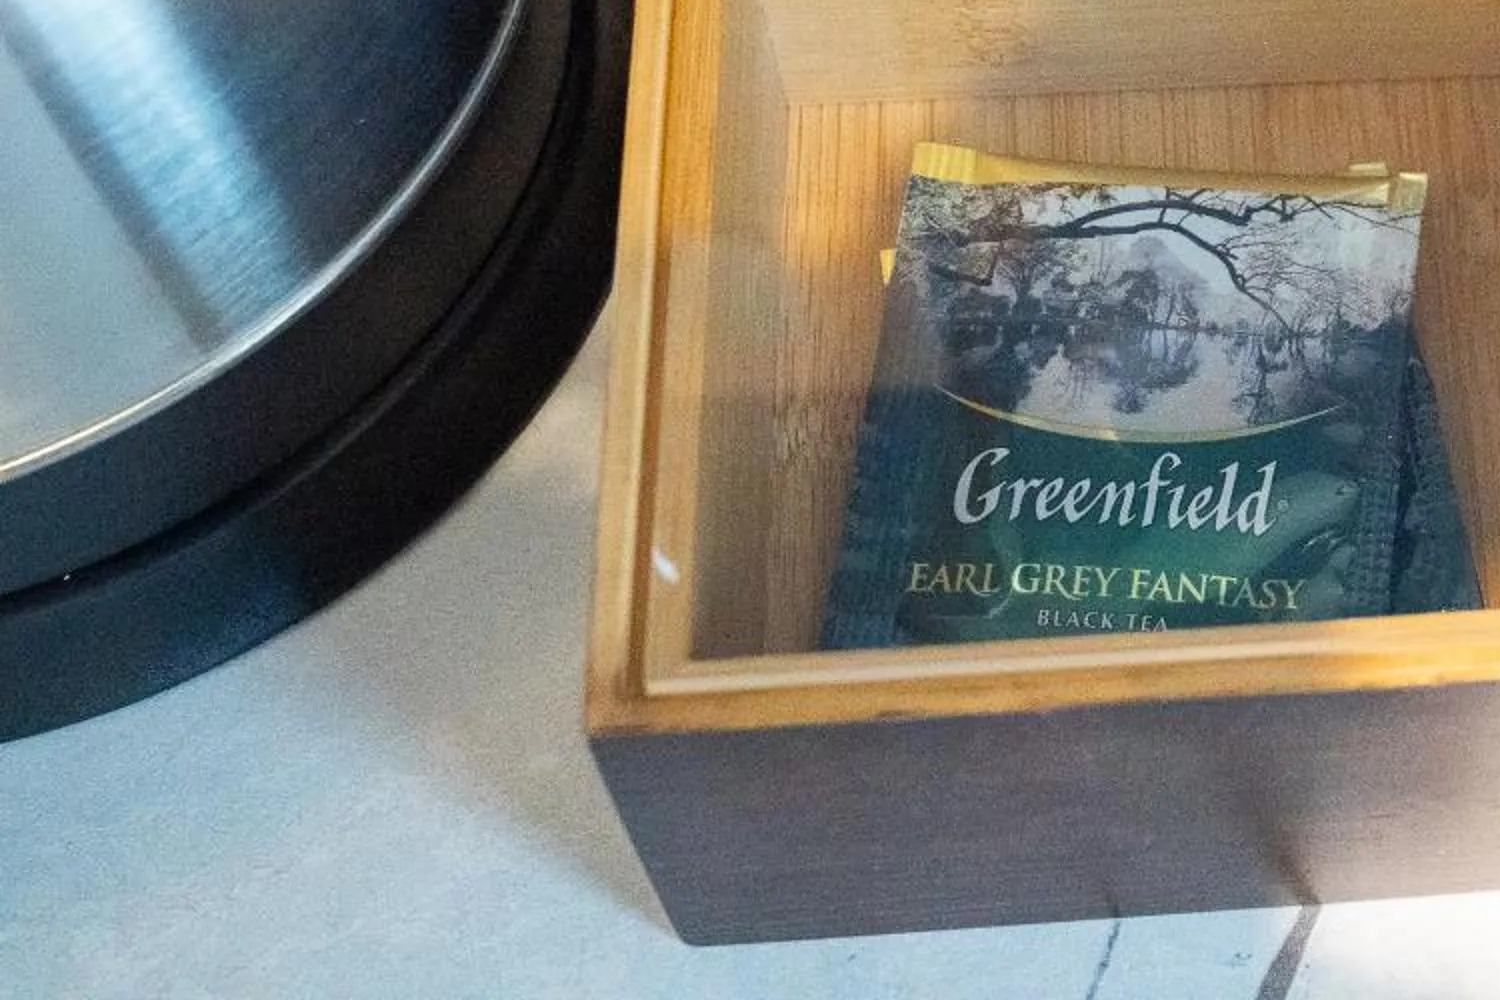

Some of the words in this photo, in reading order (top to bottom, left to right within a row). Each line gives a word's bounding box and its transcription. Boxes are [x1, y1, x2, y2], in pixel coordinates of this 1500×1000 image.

[953, 446, 1279, 537] Greenfield
[904, 561, 1000, 597] EARL
[1010, 562, 1123, 601] GREY
[1131, 567, 1308, 611] FANTASY
[1036, 608, 1115, 631] BLACK
[1125, 612, 1168, 633] TEA
